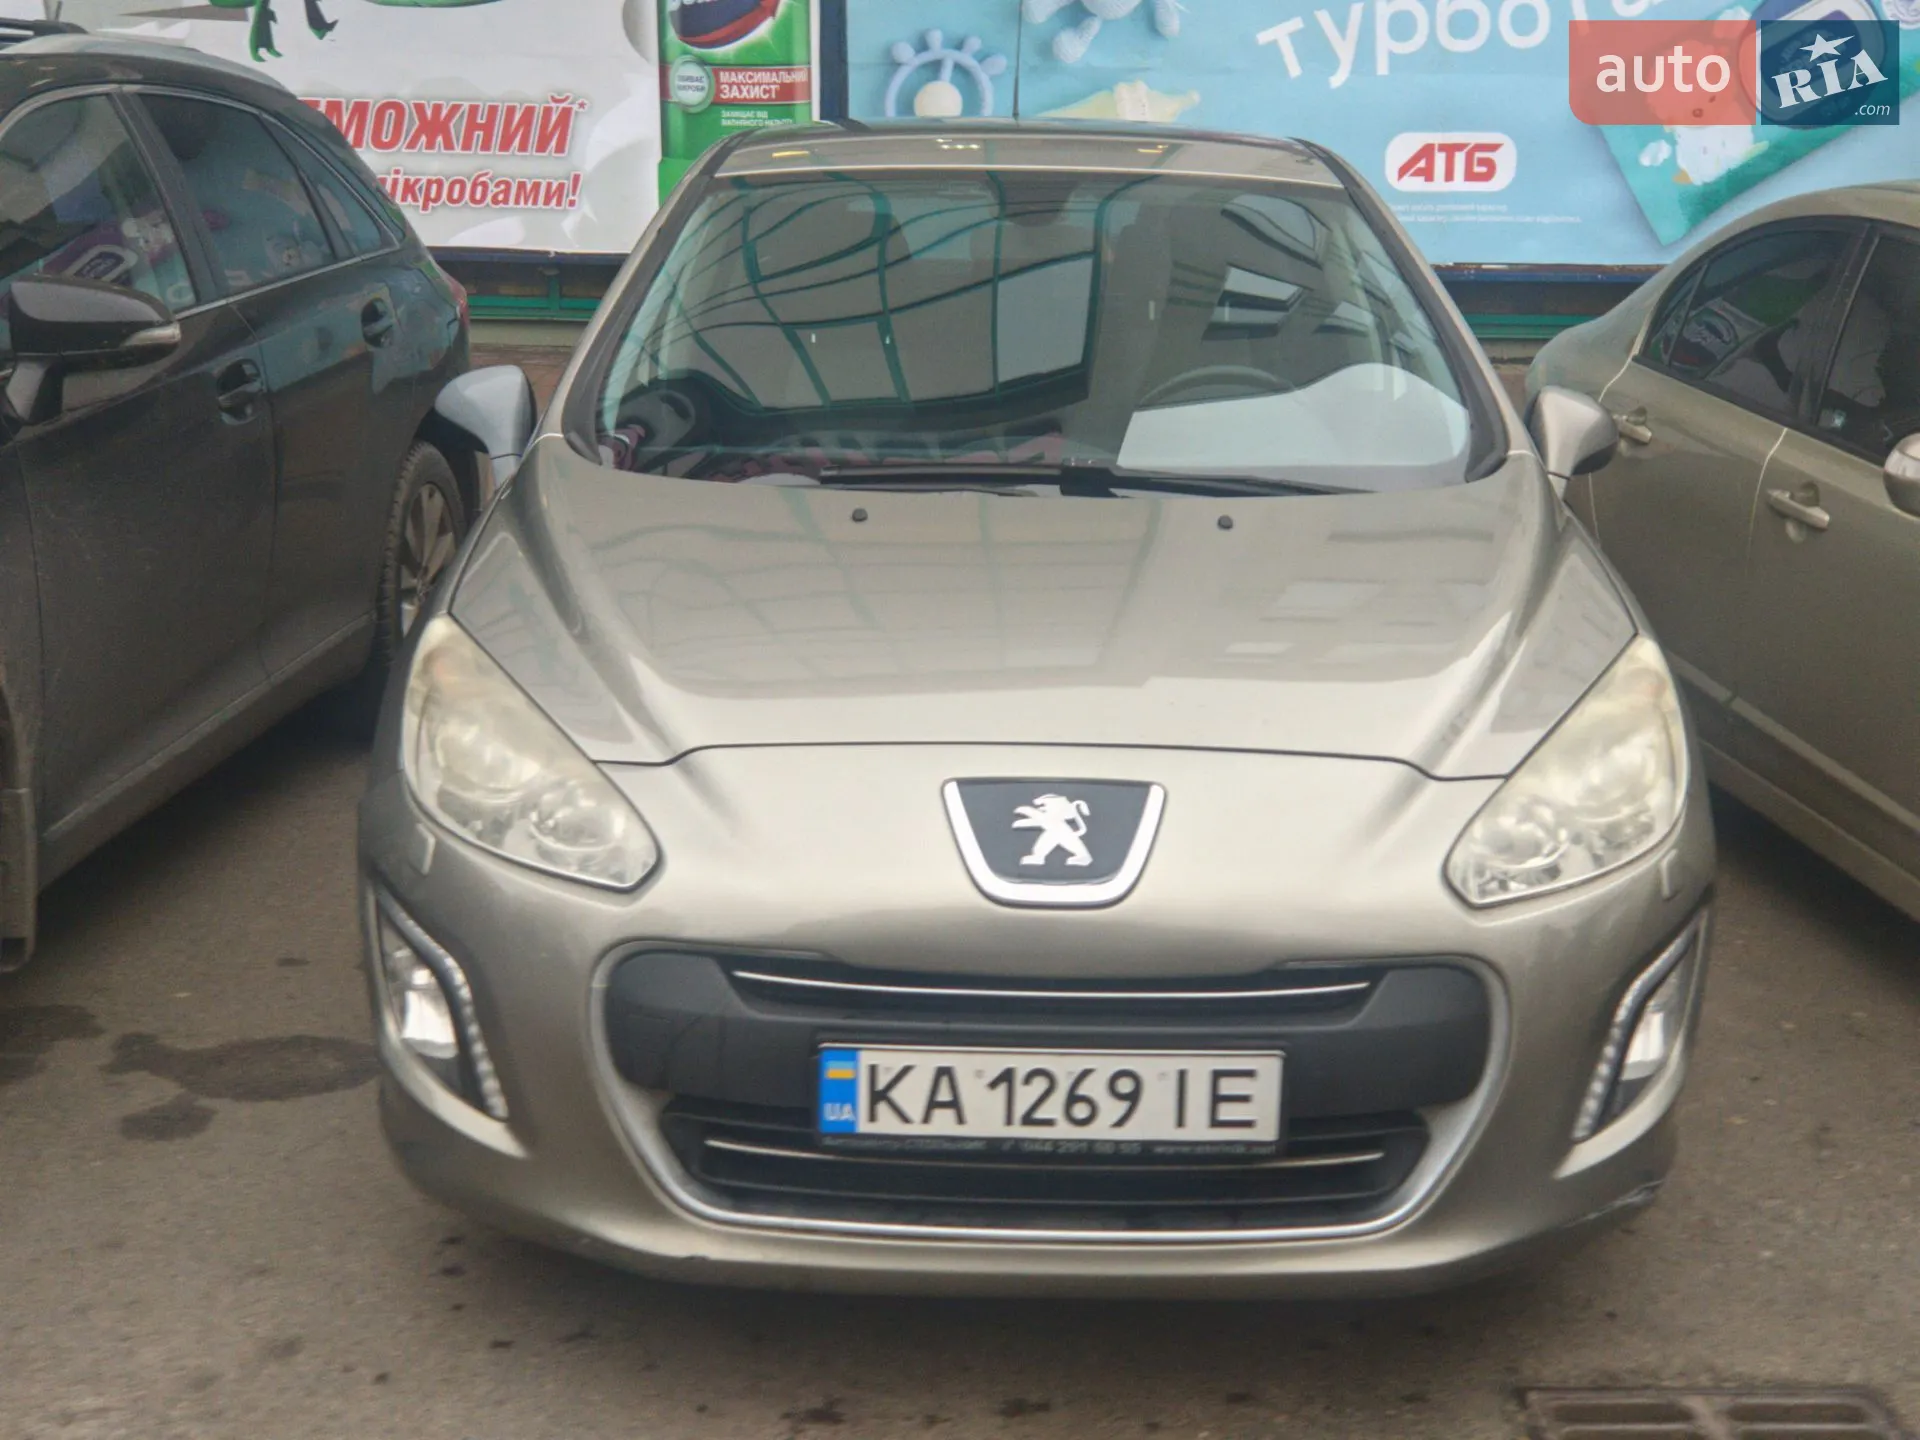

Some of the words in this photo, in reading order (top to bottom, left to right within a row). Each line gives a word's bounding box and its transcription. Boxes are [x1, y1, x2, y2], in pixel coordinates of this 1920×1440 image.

[719, 68, 808, 84] МАКСИМАЛЬНИЙ
[299, 95, 588, 156] МОЖНИЙ
[1396, 142, 1504, 183] АТБ
[824, 1102, 856, 1121] UA
[867, 1063, 967, 1126] KA
[986, 1066, 1145, 1128] 1269
[1175, 1068, 1259, 1129] IE
